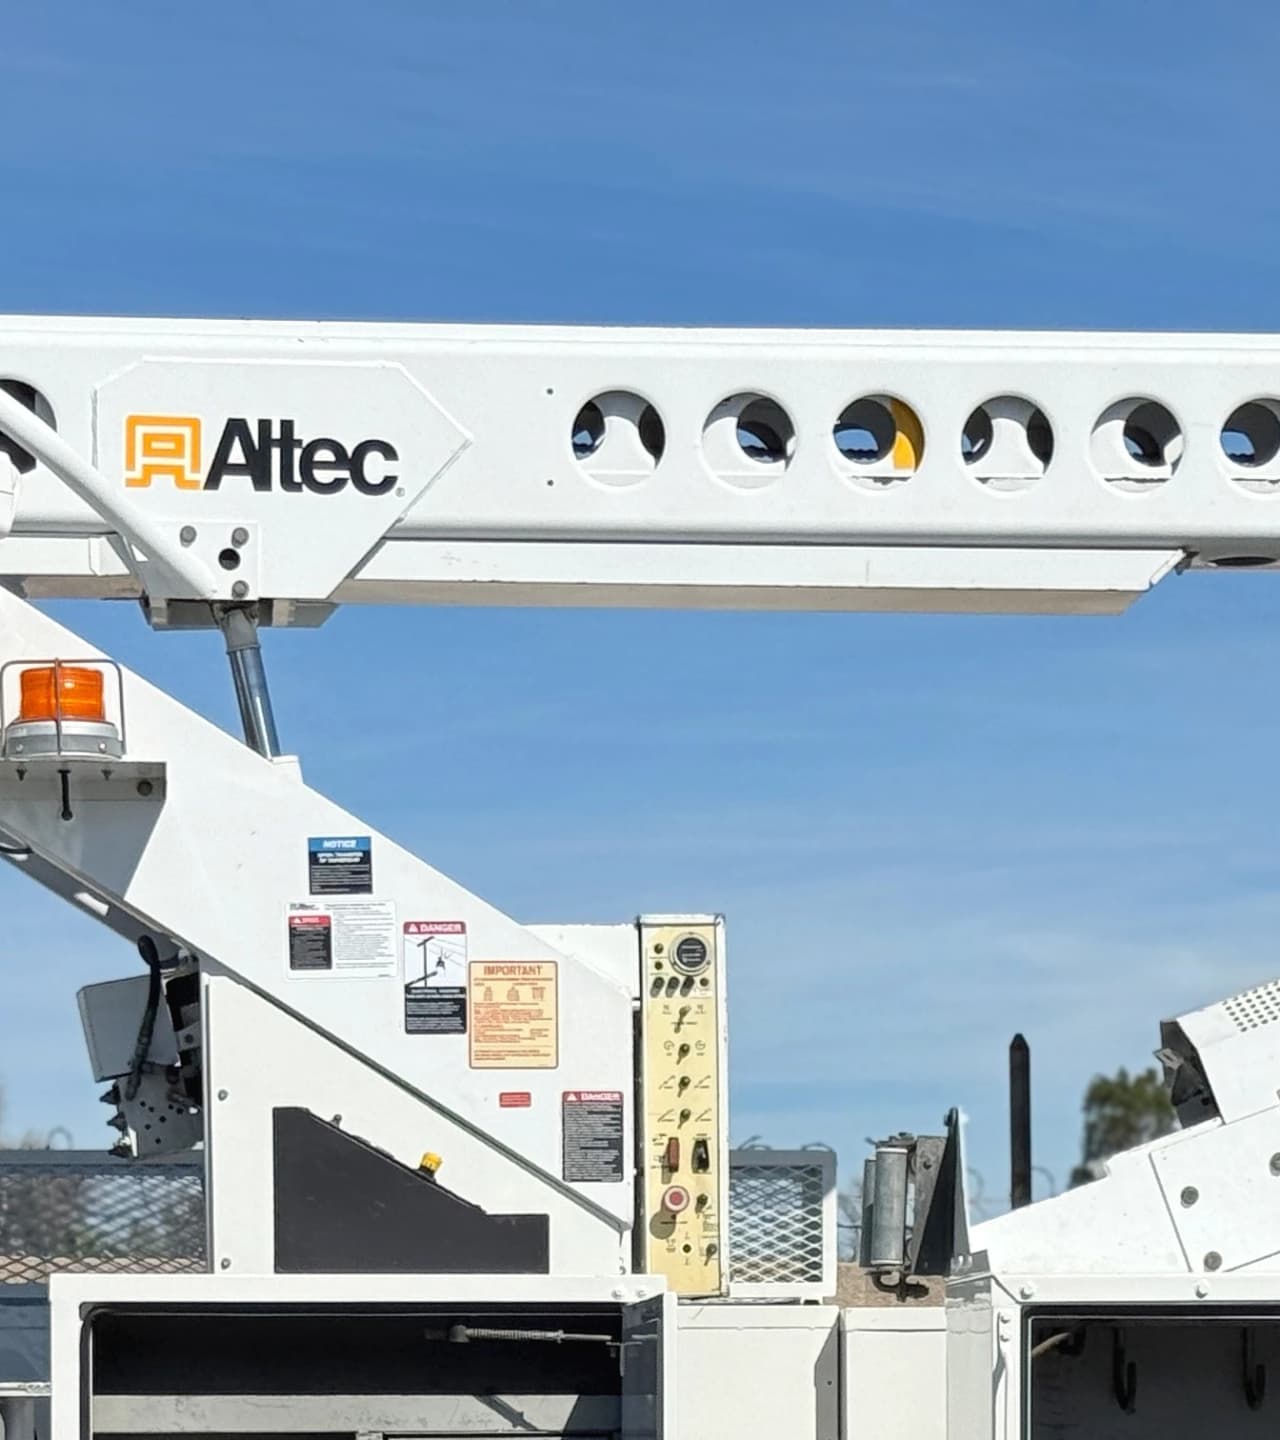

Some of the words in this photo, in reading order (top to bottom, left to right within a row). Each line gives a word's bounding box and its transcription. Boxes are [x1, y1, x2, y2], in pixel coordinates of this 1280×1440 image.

[203, 417, 400, 496] Altec
[322, 839, 357, 849] NOTICE
[420, 922, 462, 933] DANGER
[483, 964, 543, 976] IMPORTANT
